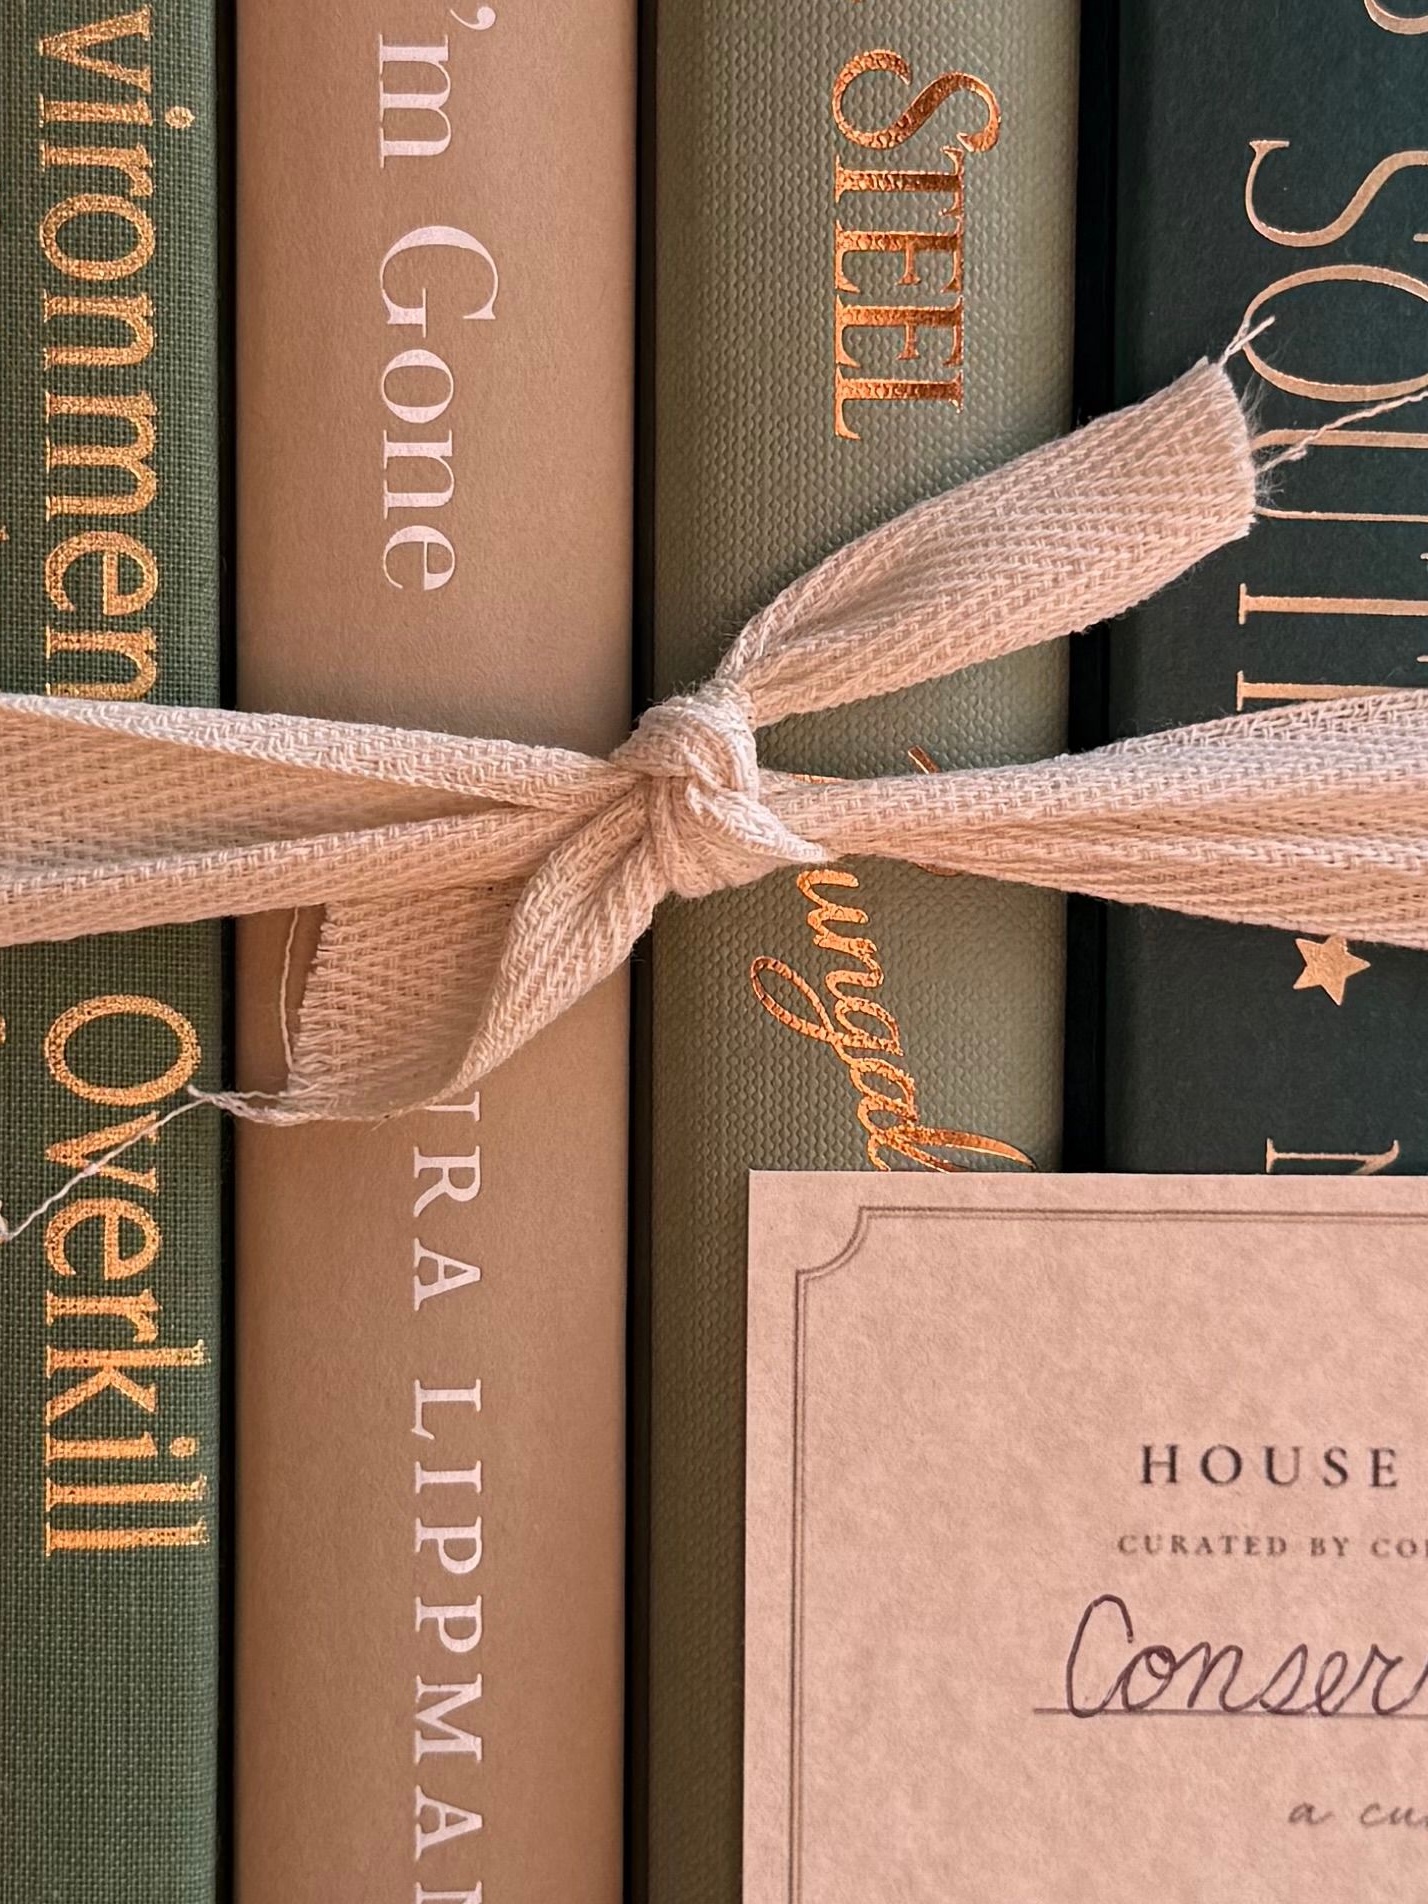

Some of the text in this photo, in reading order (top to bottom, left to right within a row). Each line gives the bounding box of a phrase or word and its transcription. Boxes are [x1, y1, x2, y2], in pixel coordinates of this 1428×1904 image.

[831, 49, 1002, 441] STEEL
[378, 223, 500, 592] Gone
[44, 994, 210, 1559] Overkill
[1116, 1533, 1288, 1558] CURATED
[1310, 1535, 1350, 1559] BY
[1139, 1443, 1400, 1490] HOUSE
[1286, 1798, 1335, 1831] a
